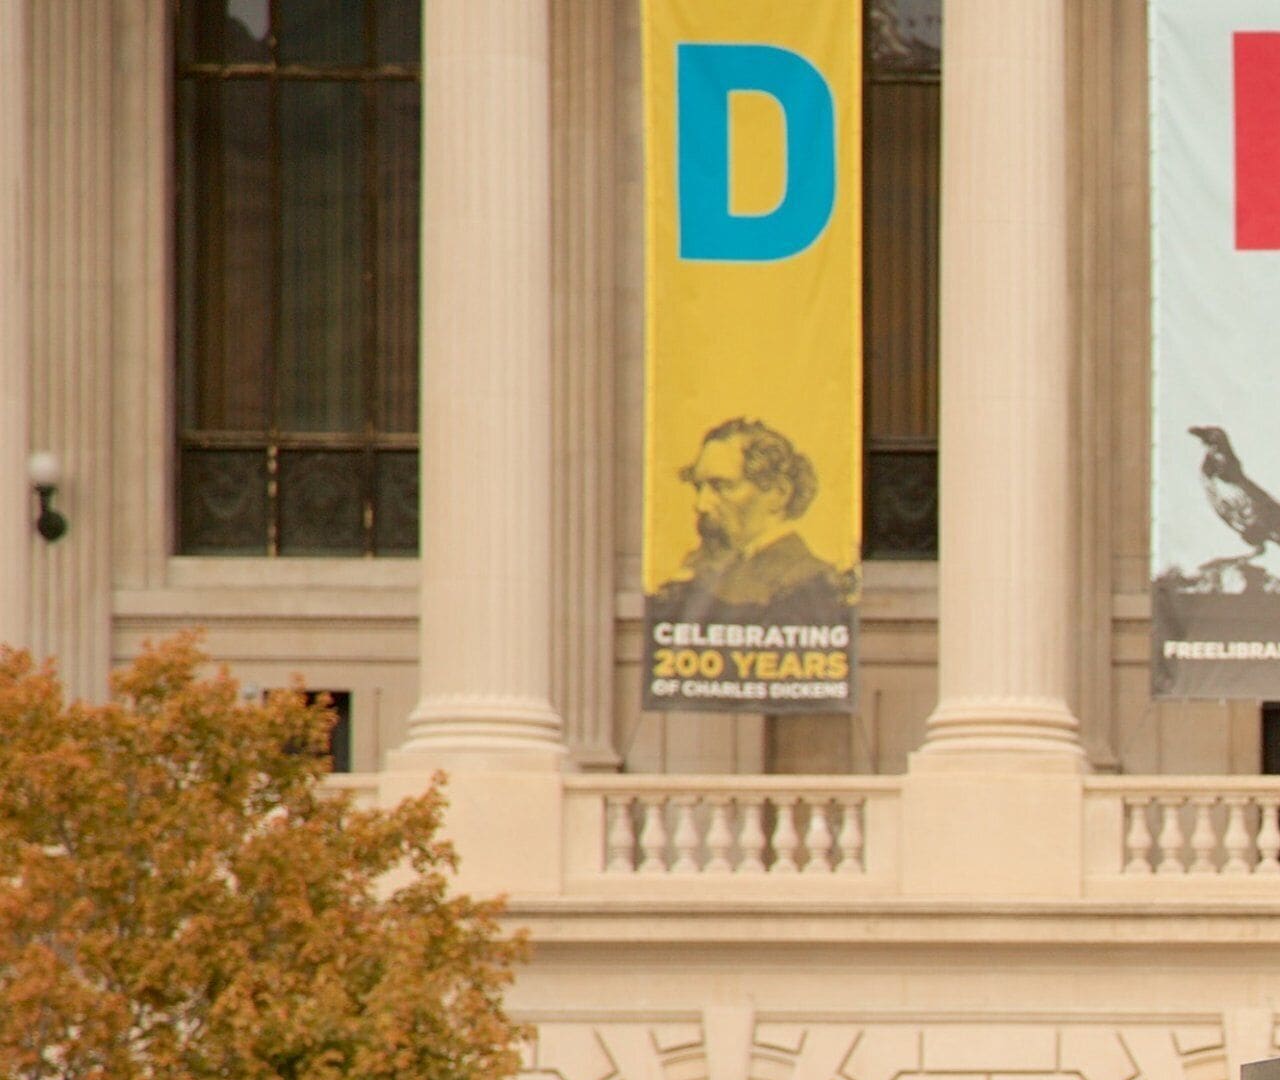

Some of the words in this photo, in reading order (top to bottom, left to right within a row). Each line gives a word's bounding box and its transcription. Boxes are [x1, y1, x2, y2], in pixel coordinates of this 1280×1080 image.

[676, 43, 837, 262] D
[653, 622, 850, 648] CELEBRATING
[653, 649, 725, 678] 200
[731, 651, 849, 680] YEARS
[651, 679, 680, 696] OF
[681, 680, 768, 699] CHARLES
[769, 682, 849, 699] DICKENS
